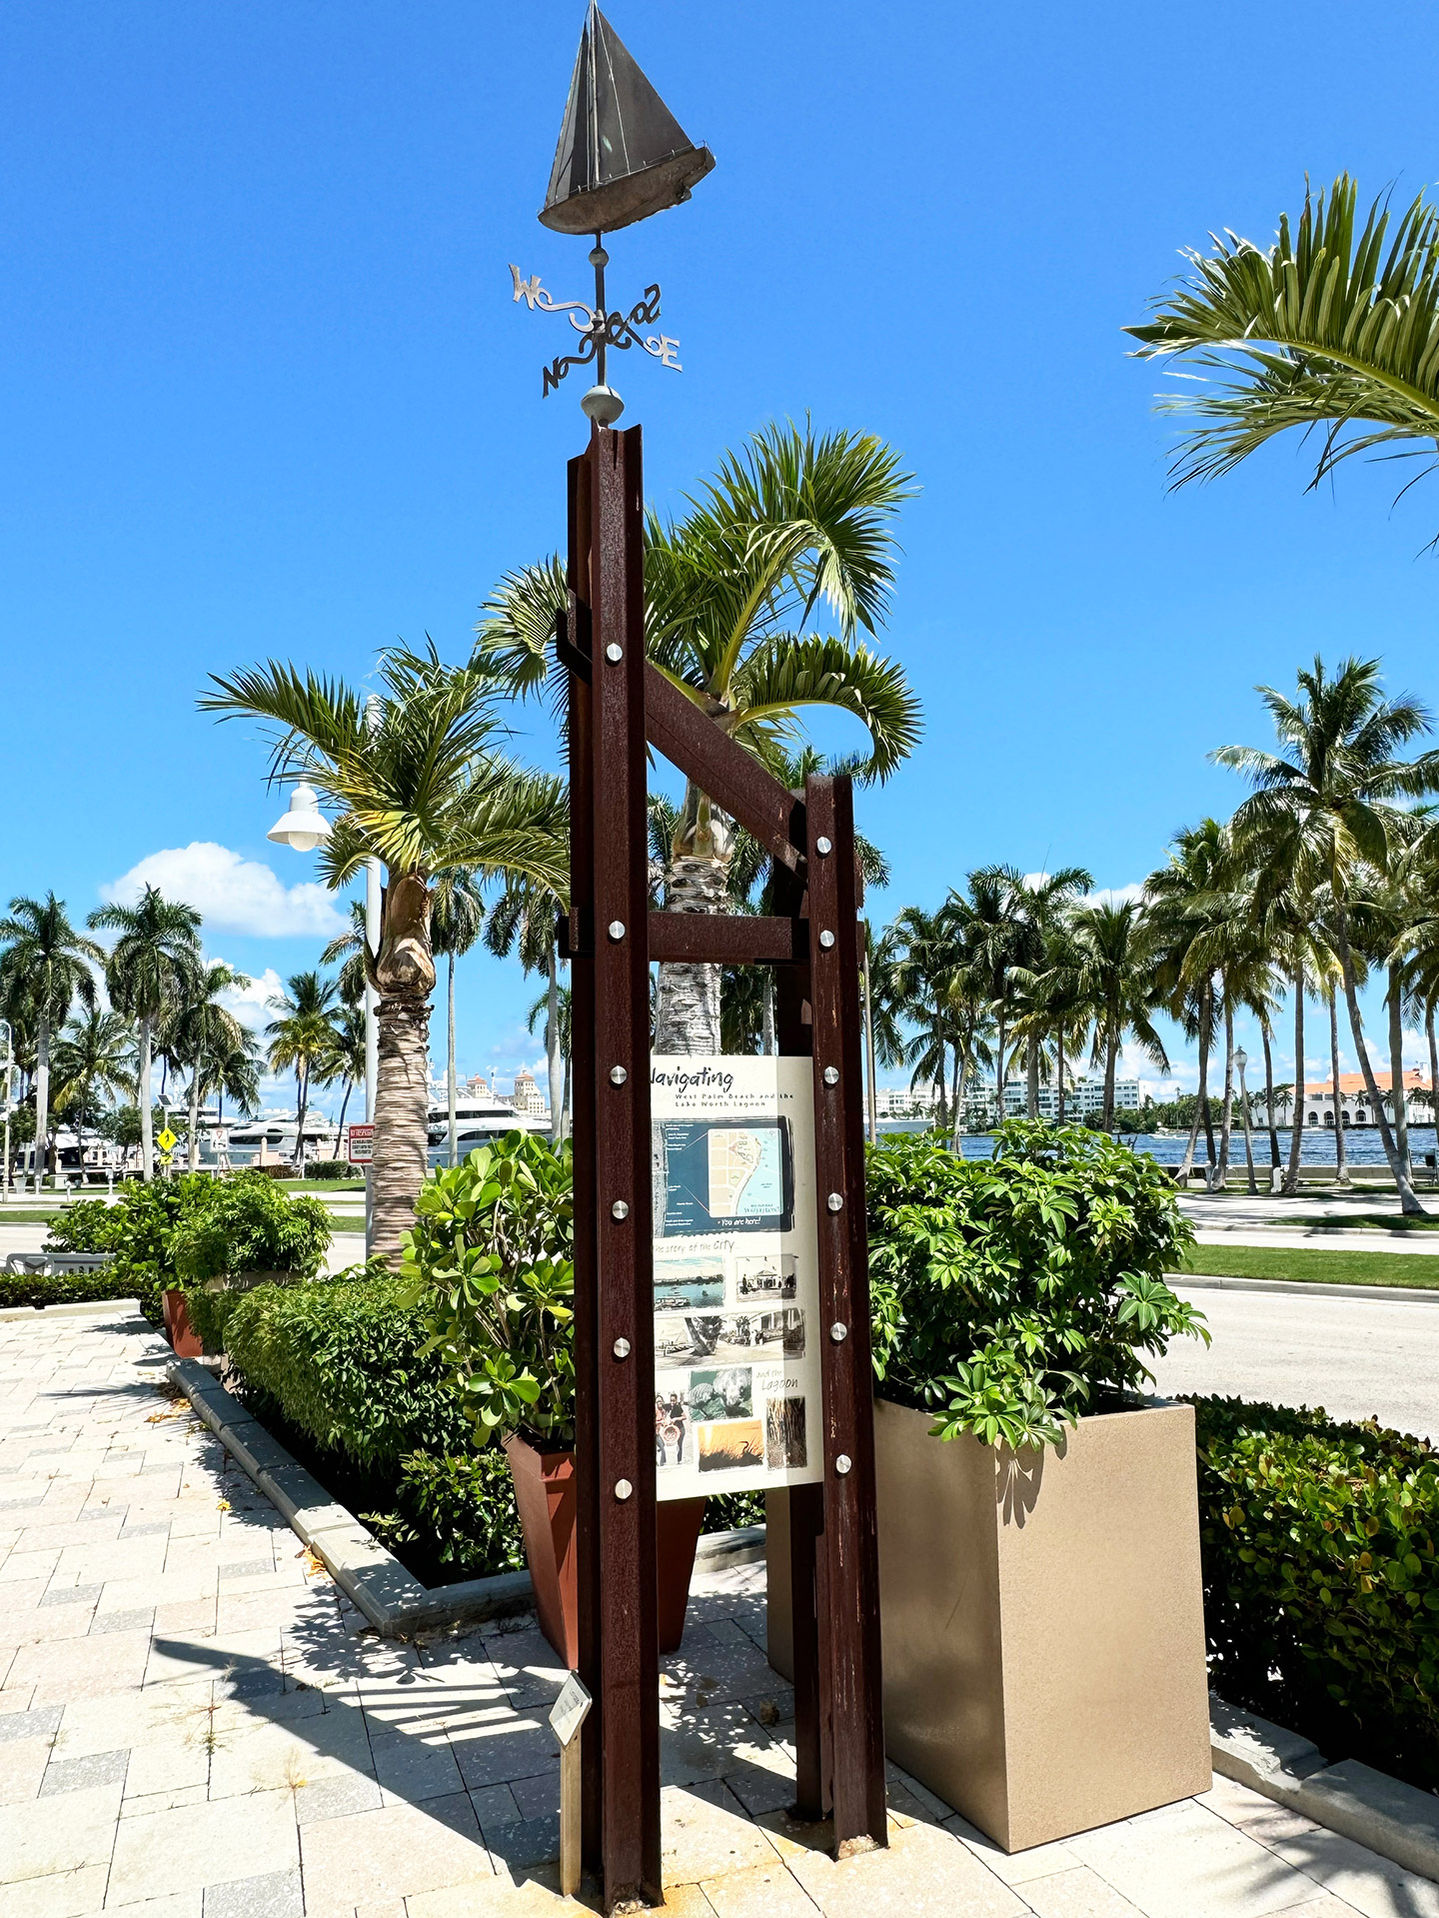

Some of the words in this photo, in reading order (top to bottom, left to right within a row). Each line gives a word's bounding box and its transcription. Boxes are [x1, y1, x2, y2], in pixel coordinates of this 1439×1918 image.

[508, 264, 541, 310] W
[659, 333, 683, 373] E
[543, 356, 560, 399] N
[762, 1378, 798, 1392] Lagoon
